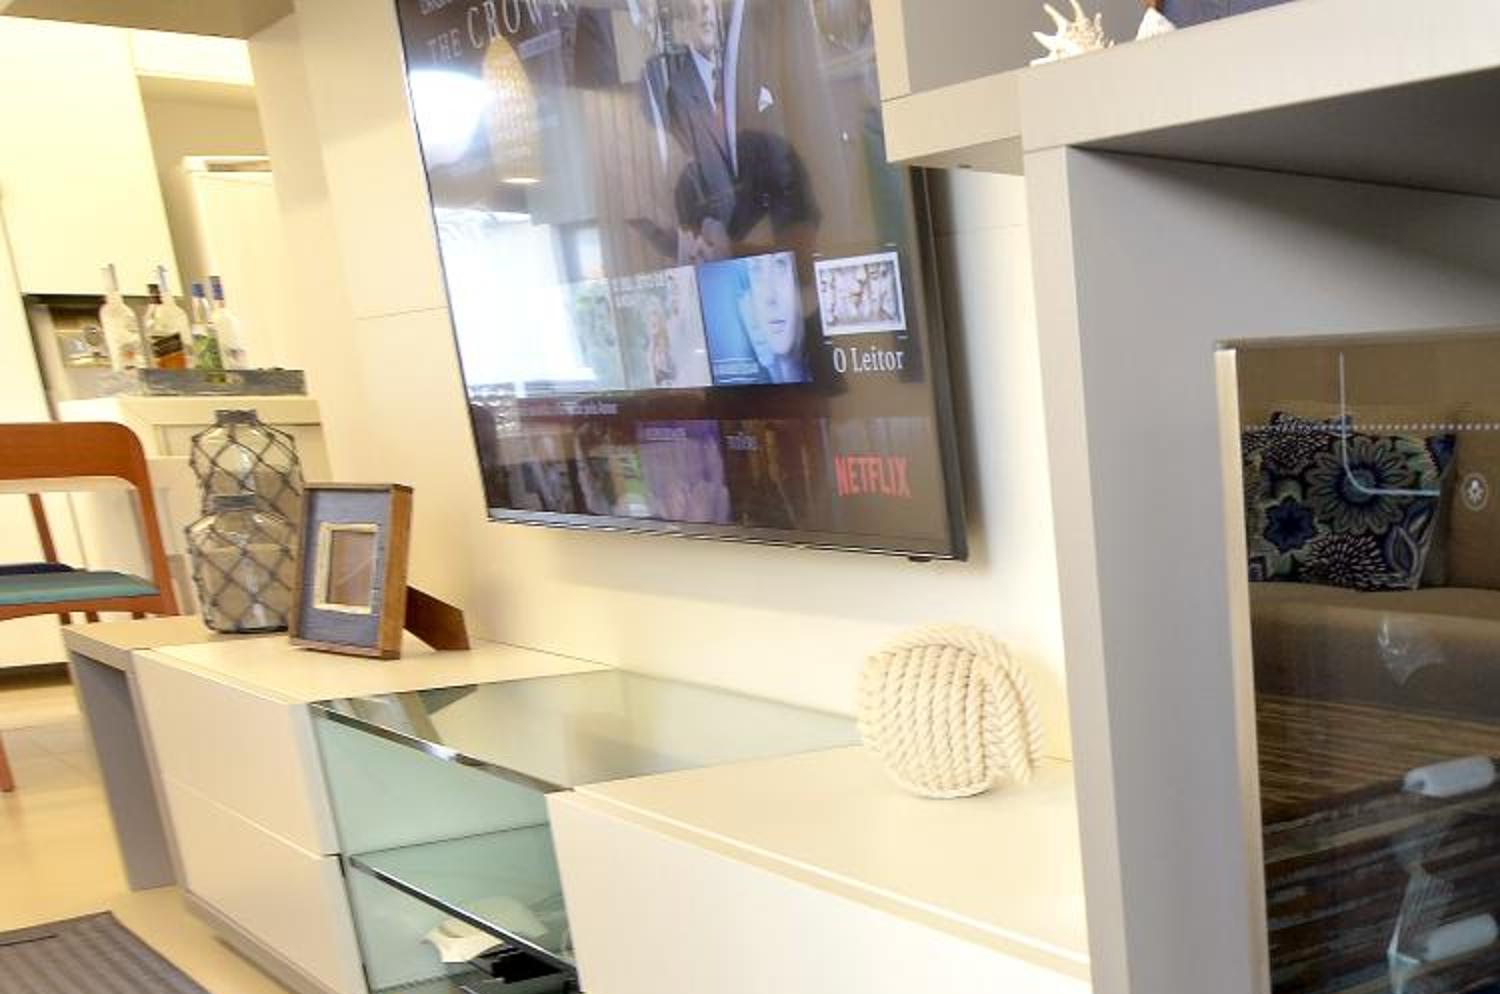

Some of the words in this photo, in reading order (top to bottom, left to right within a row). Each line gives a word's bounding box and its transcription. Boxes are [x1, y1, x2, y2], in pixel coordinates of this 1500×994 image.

[833, 347, 847, 373] O
[850, 346, 905, 373] Leitor
[835, 453, 913, 497] NETFLIX
